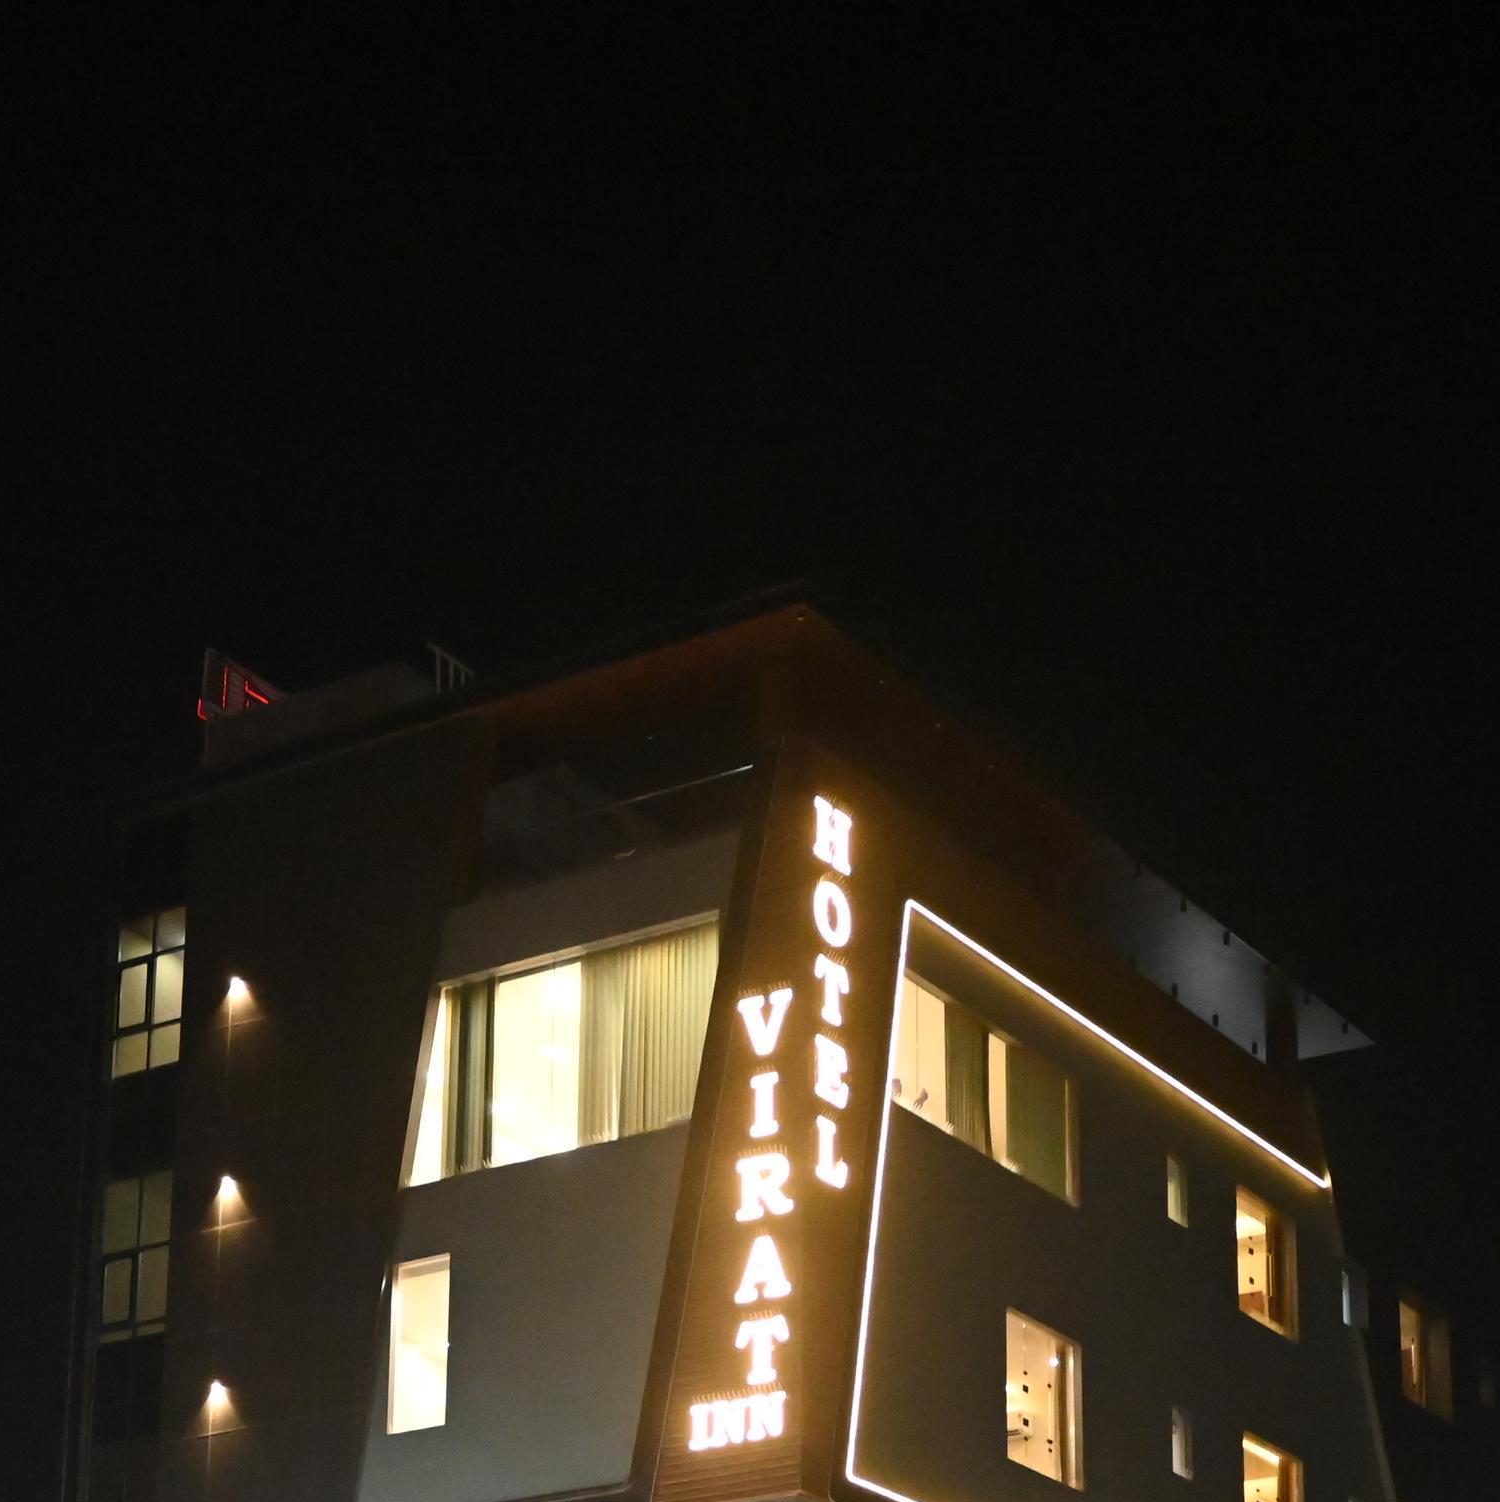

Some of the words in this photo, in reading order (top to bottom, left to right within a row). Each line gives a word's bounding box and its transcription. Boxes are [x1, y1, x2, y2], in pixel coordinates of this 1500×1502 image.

[735, 988, 794, 1386] VIRAT
[813, 796, 852, 1188] HOTEL
[689, 1392, 786, 1450] INN
